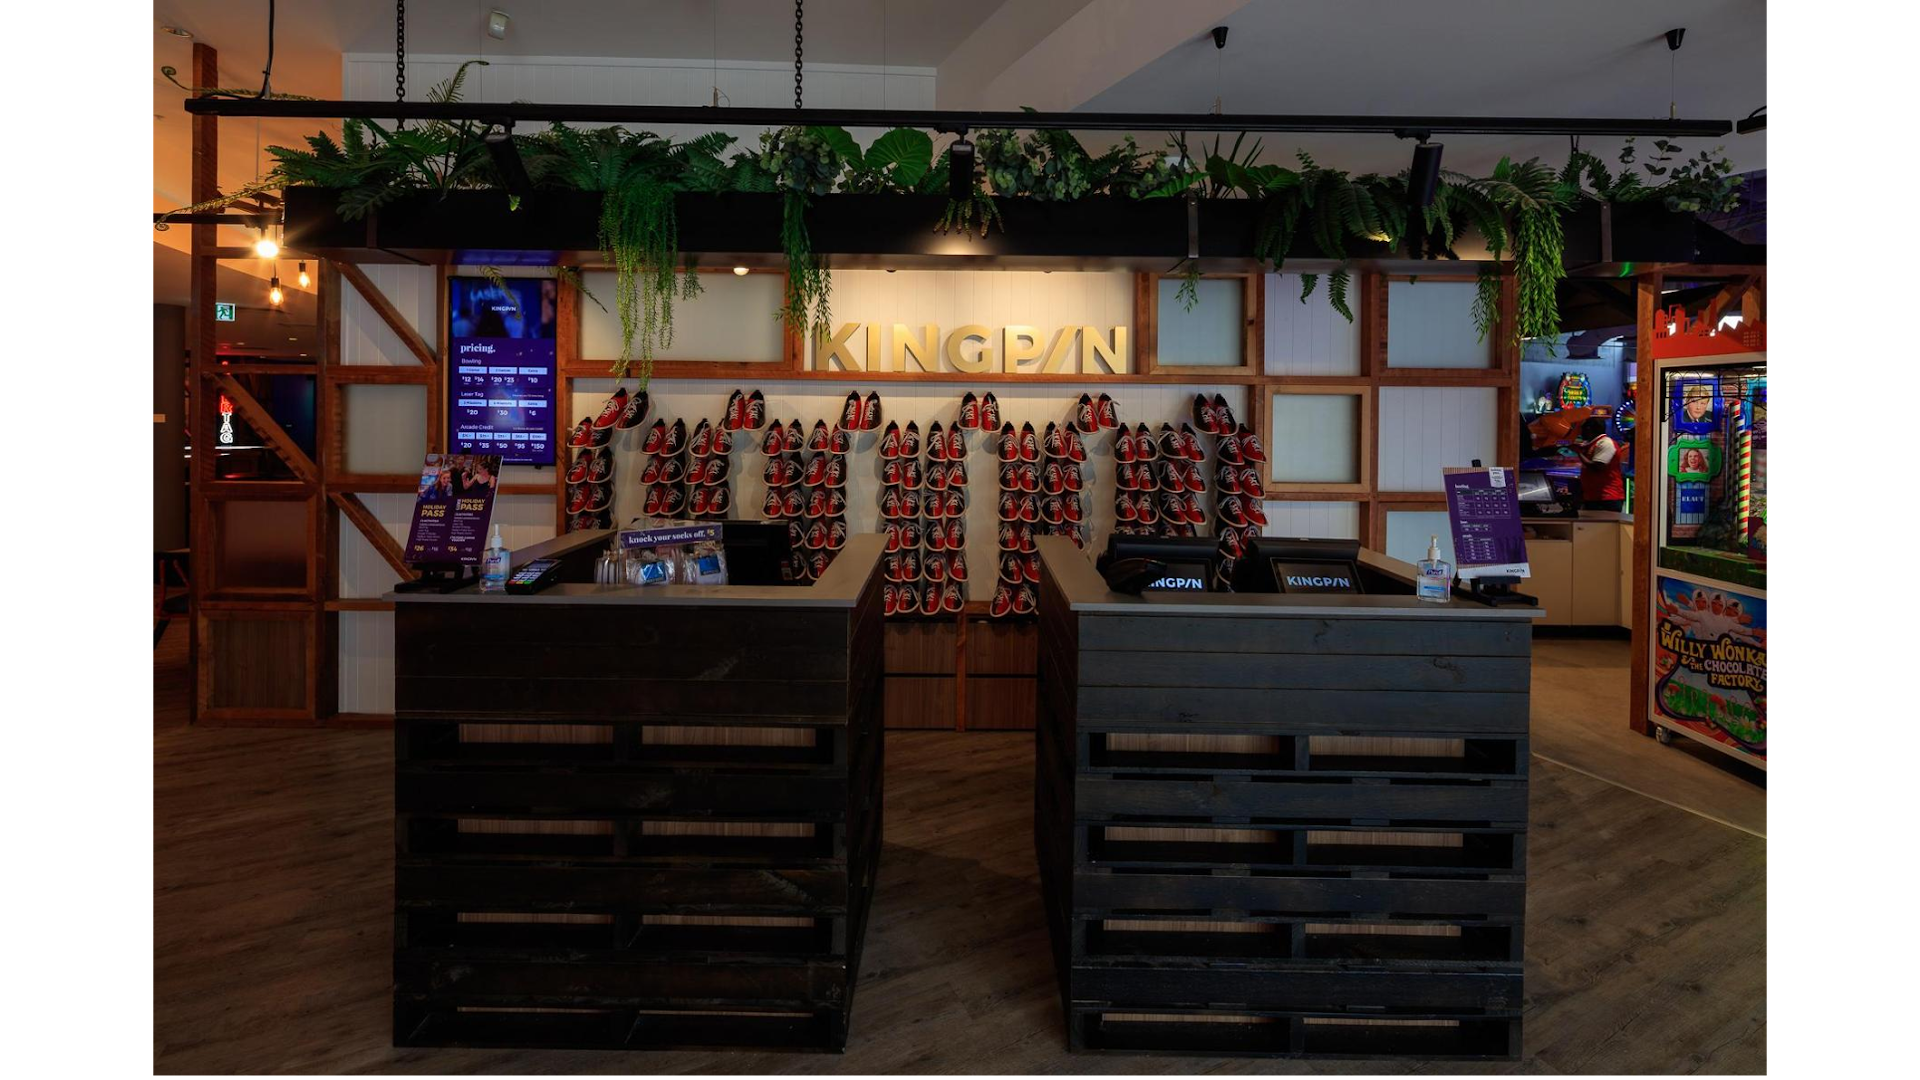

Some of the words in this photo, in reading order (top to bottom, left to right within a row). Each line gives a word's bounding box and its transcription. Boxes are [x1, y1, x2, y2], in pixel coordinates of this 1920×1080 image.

[460, 343, 496, 354] pricing.
[219, 412, 234, 444] TAG
[421, 510, 445, 518] PASS
[460, 503, 484, 511] PASS
[628, 535, 653, 544] knock
[653, 534, 671, 543] your
[672, 531, 693, 540] socks
[1660, 628, 1705, 659] WILLY
[1710, 637, 1767, 668] WONKA
[1690, 662, 1703, 671] THE
[1704, 659, 1767, 681] CHOCOLATE
[1711, 673, 1765, 693] FACTORY
